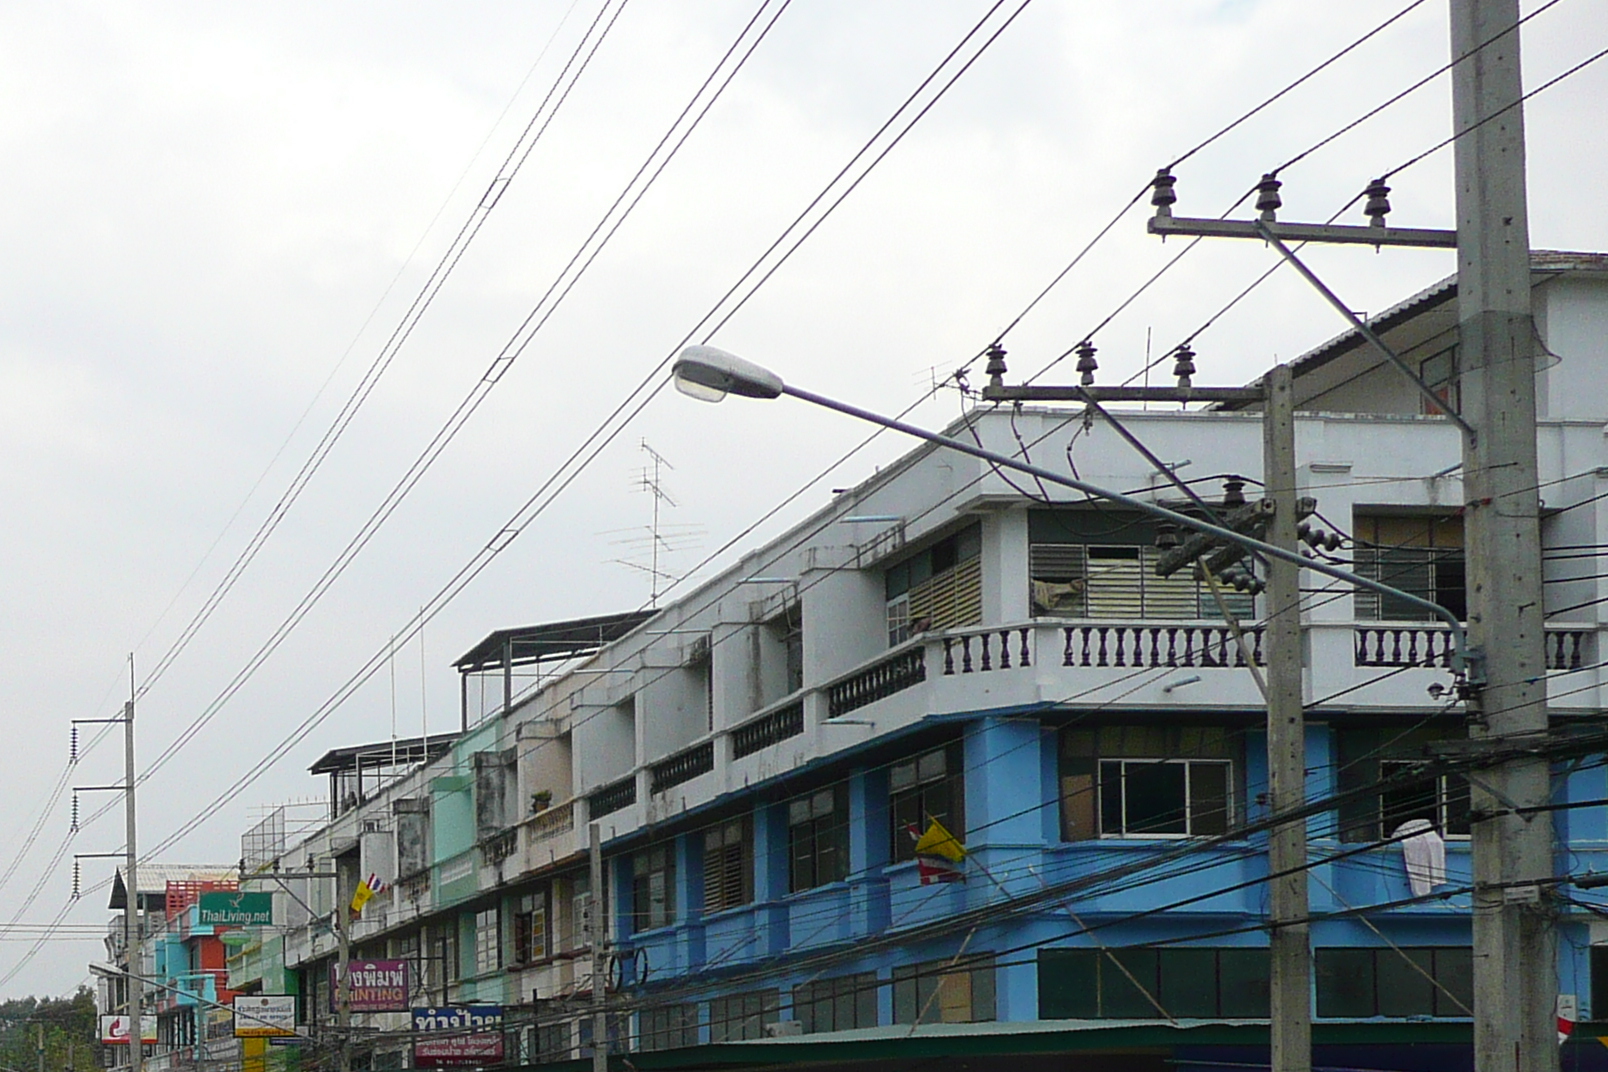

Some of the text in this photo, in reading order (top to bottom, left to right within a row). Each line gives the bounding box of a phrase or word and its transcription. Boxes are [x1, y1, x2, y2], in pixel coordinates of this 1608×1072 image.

[202, 910, 270, 925] ThaiLiving.net
[334, 963, 405, 987] โงพิมพ์
